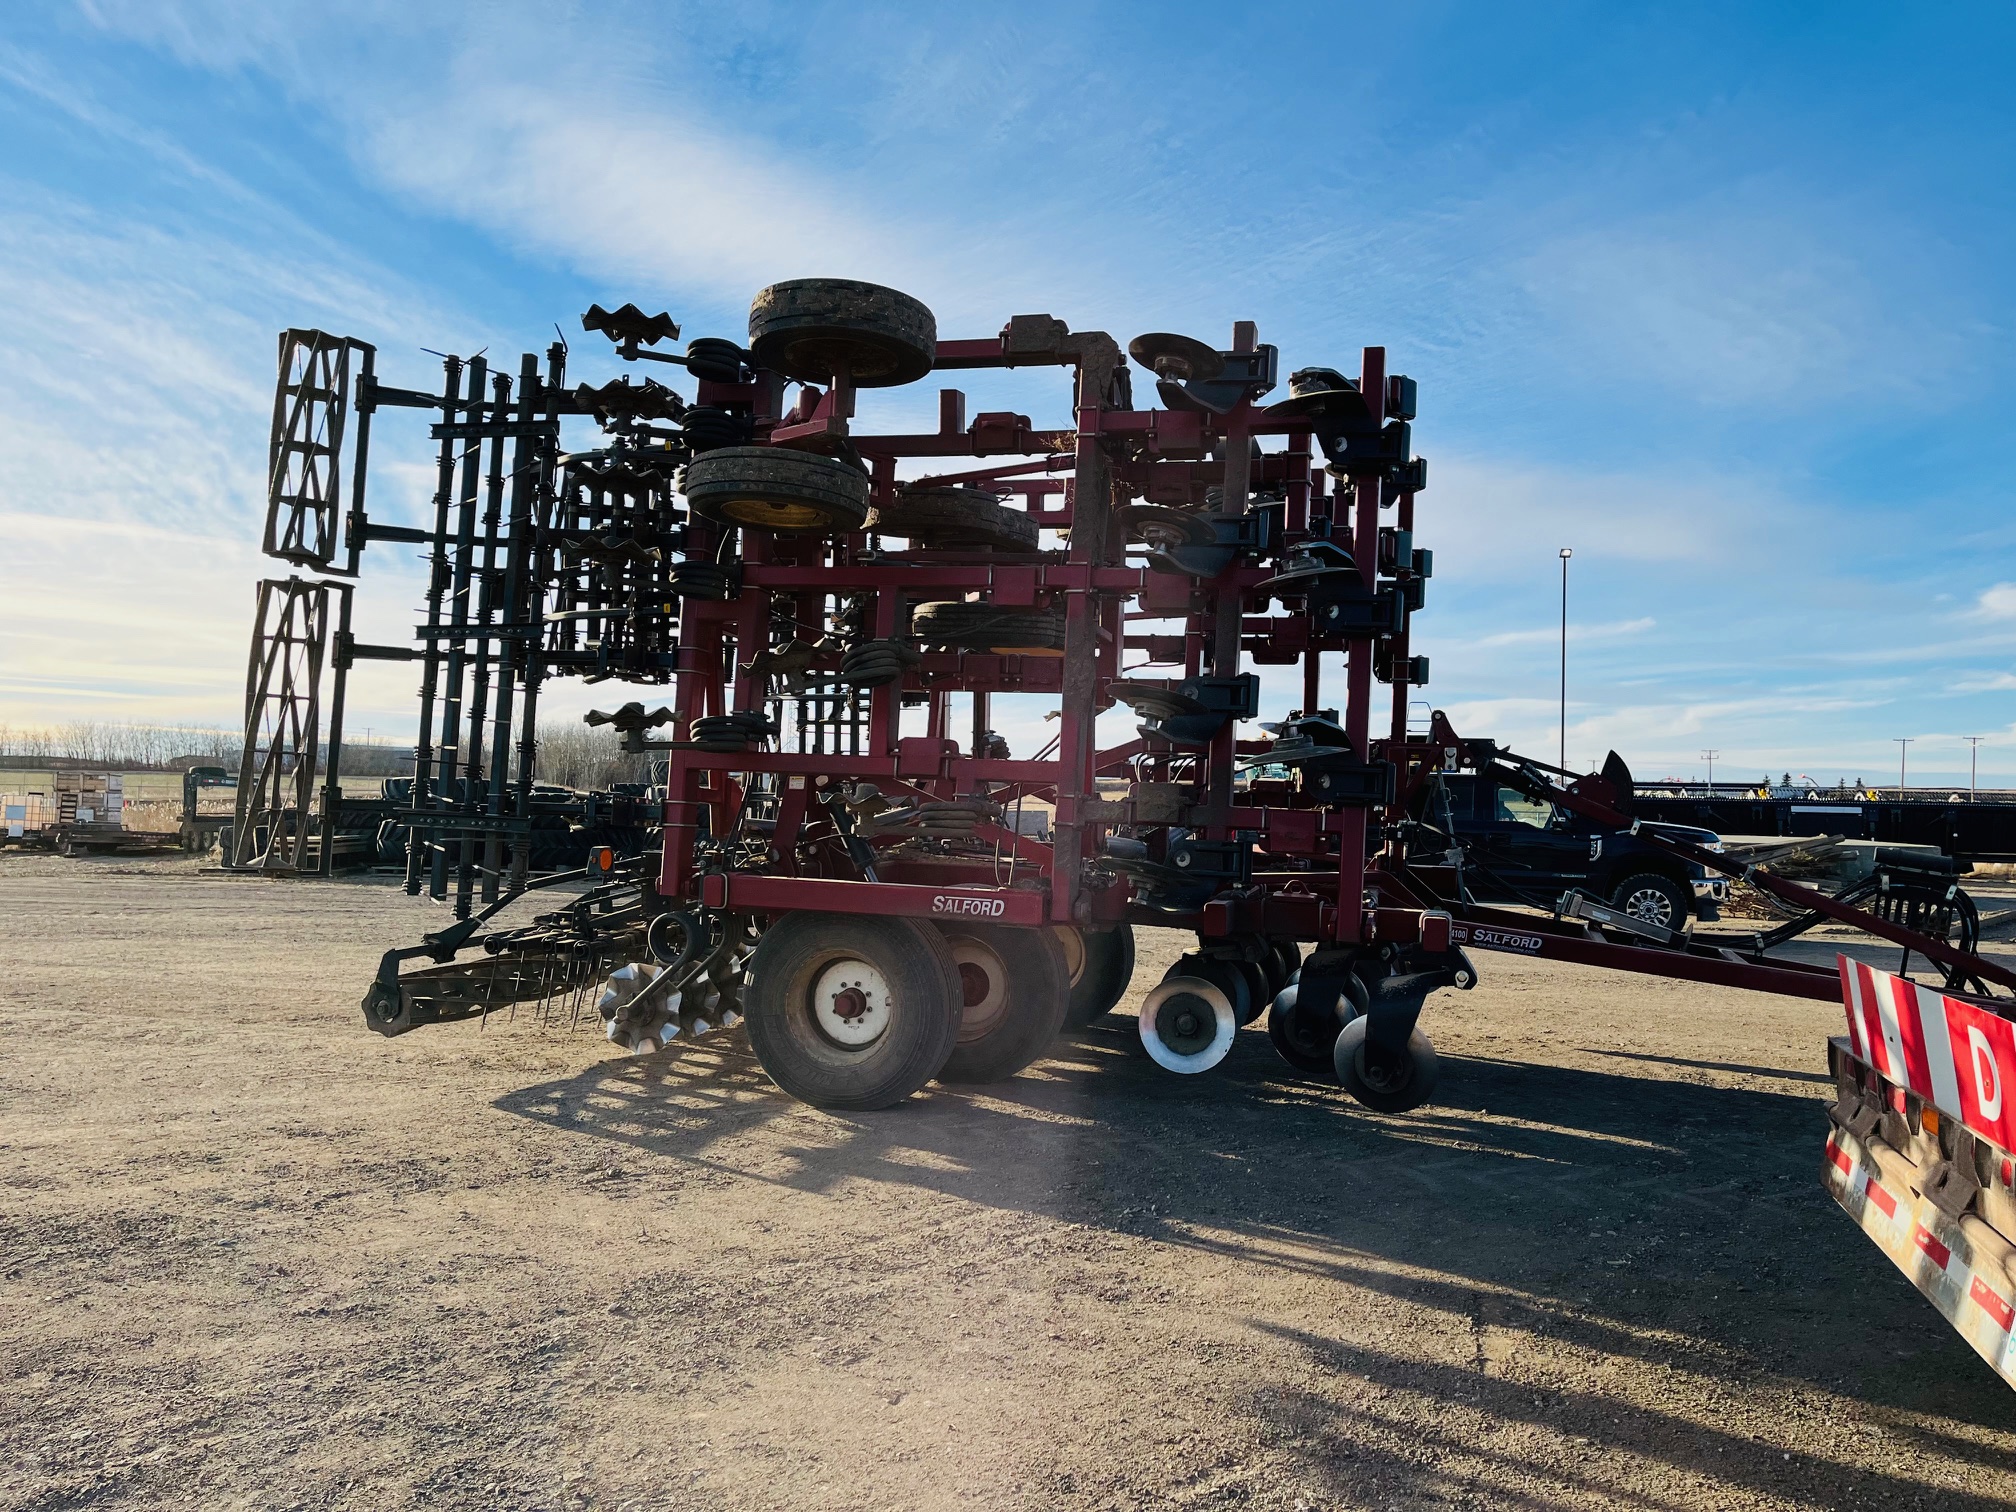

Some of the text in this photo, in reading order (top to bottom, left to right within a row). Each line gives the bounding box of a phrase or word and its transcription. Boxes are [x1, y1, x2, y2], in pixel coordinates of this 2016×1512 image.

[932, 895, 1005, 917] SALFORD
[1473, 929, 1543, 949] SALFORD
[1967, 1025, 2002, 1122] D
